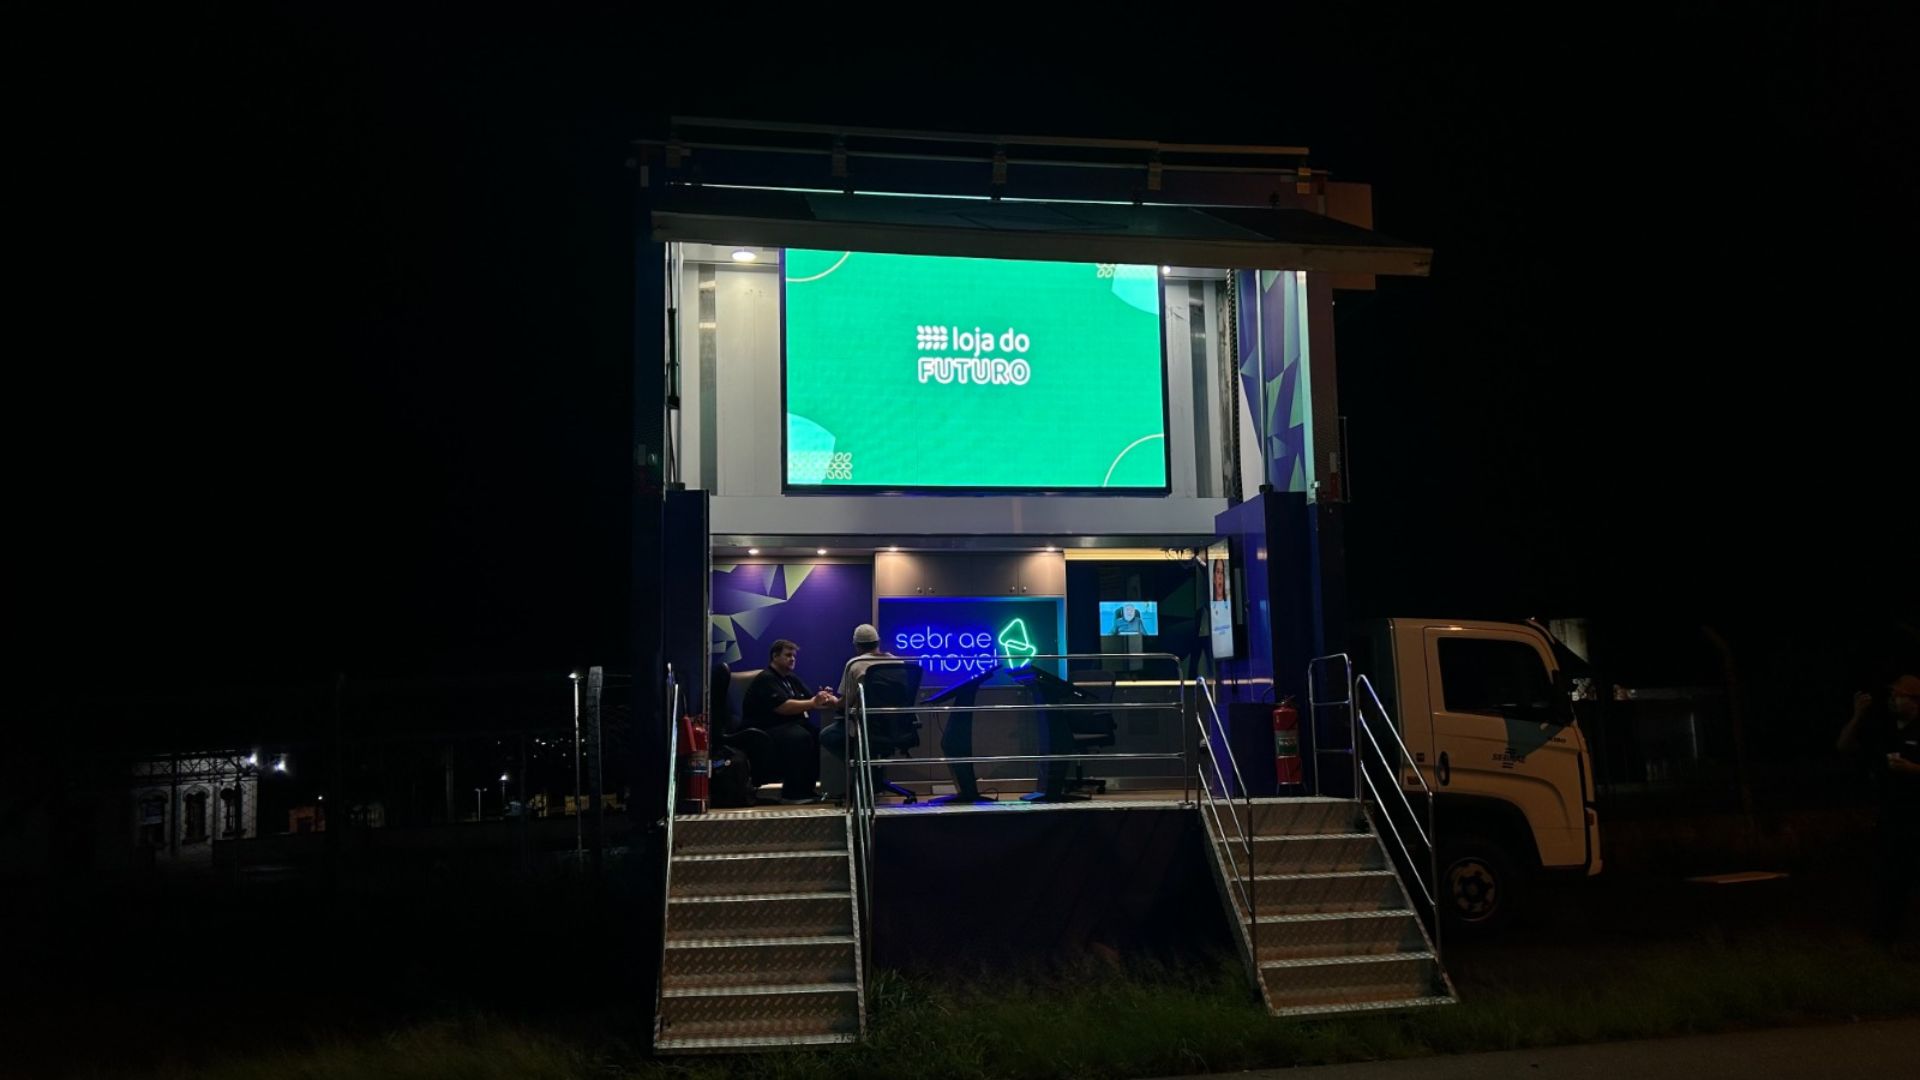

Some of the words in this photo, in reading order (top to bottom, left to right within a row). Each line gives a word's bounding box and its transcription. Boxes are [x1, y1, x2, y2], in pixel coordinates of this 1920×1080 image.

[951, 325, 995, 358] loja
[999, 326, 1031, 353] do
[917, 356, 1032, 386] FUTURO
